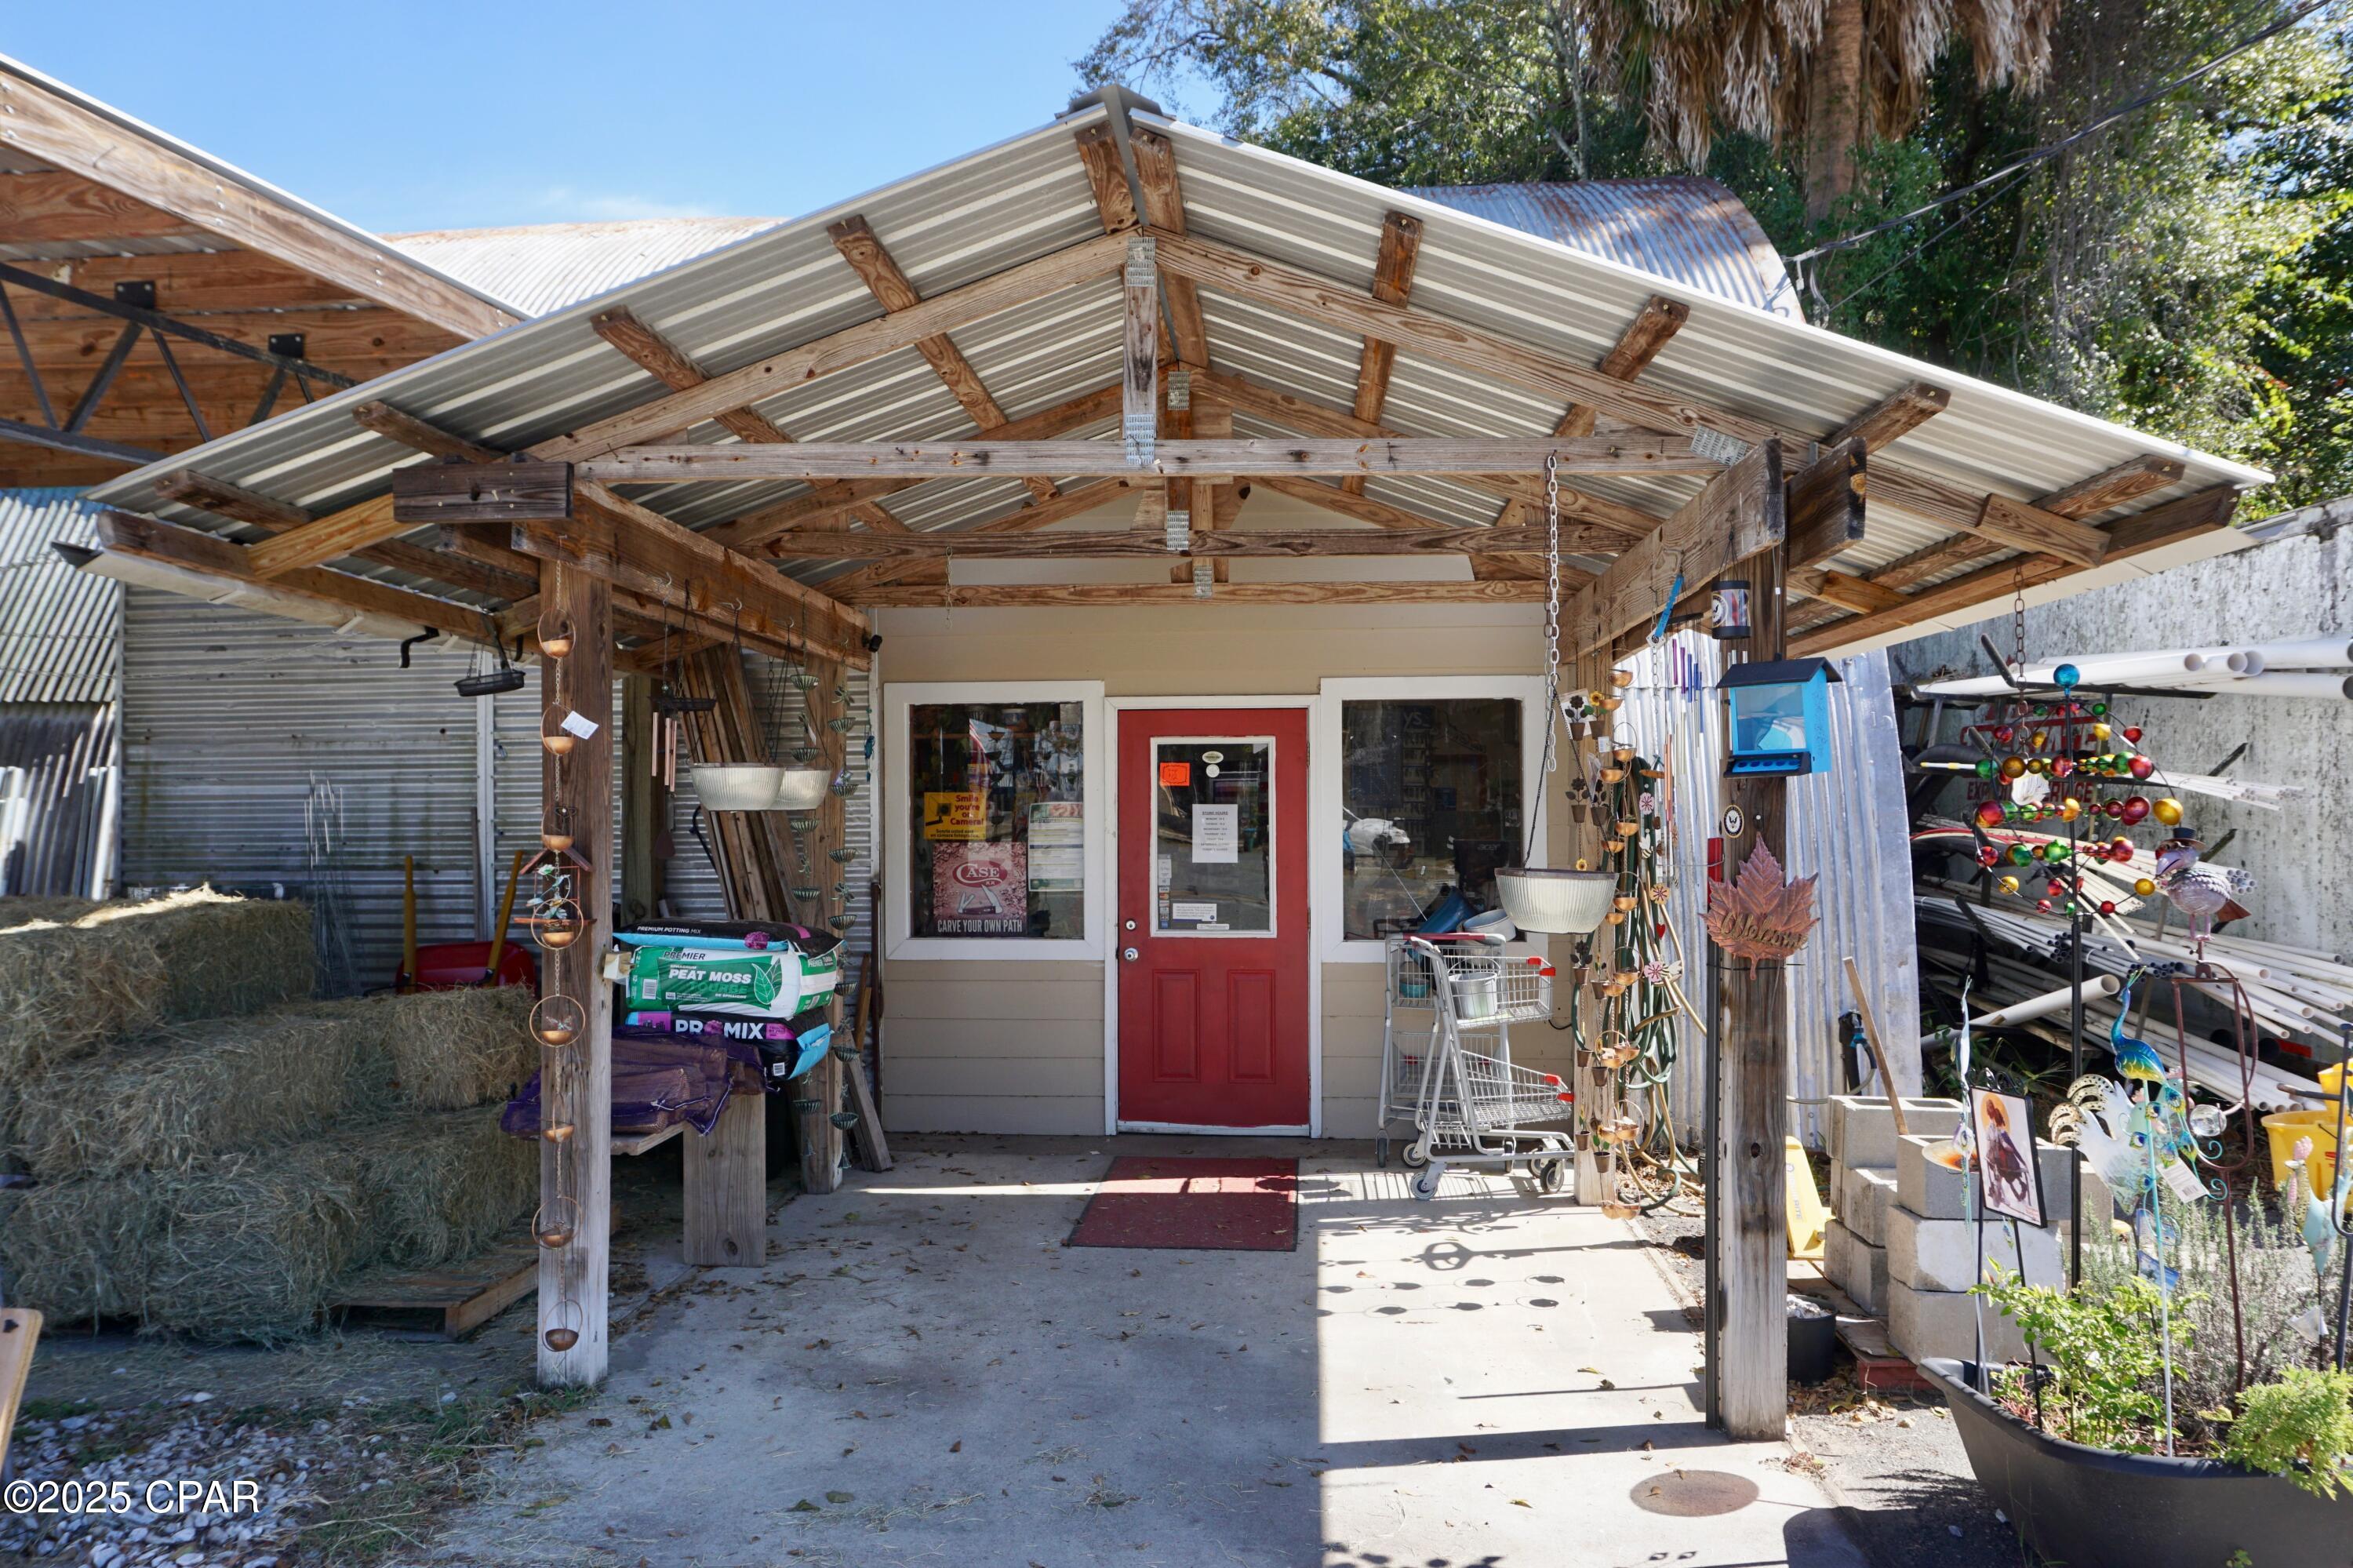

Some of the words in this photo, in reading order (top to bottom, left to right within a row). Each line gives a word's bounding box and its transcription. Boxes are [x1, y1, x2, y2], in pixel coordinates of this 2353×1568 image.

[956, 863, 1002, 883] CASE
[938, 919, 962, 933] CARVE
[963, 919, 982, 933] YOUR
[984, 919, 1002, 933] OWN
[1003, 919, 1022, 933] PATH
[664, 951, 706, 960] PREMIER
[668, 970, 706, 980] PEAT
[709, 971, 751, 984] MOSS
[690, 981, 748, 995] TOURBE
